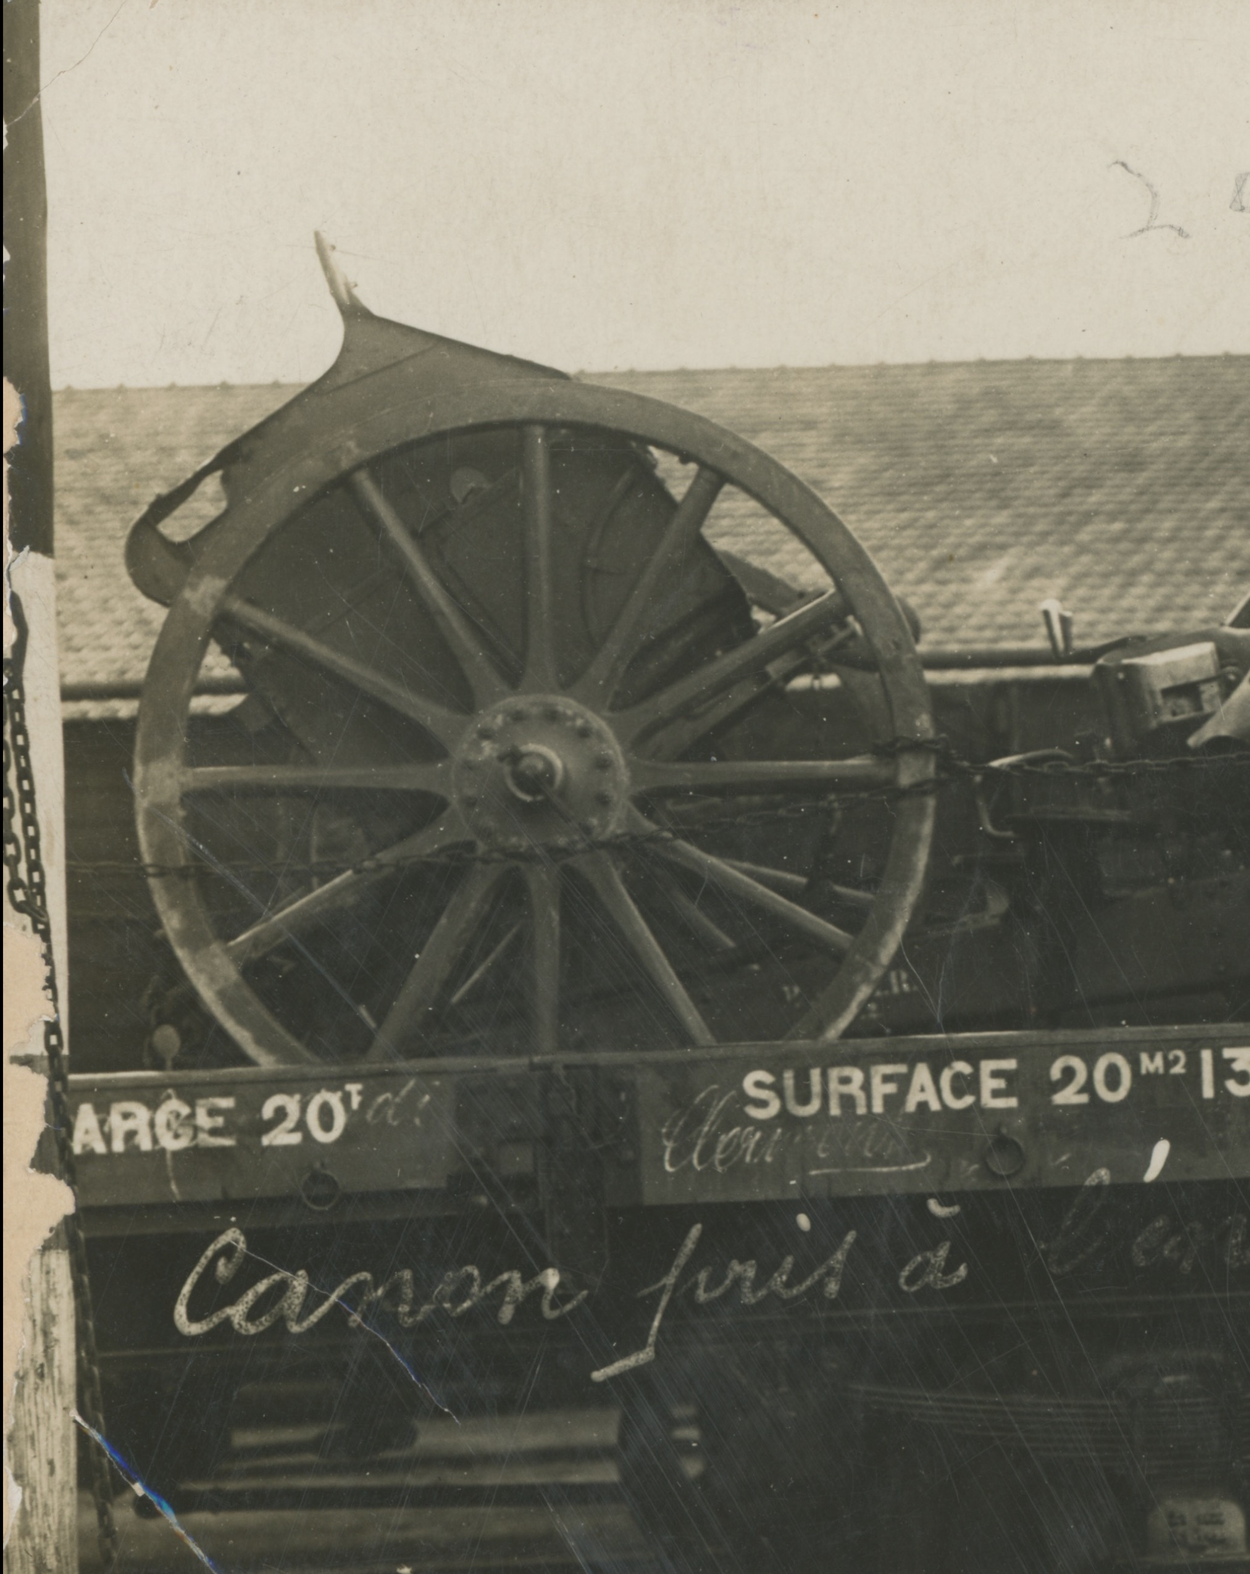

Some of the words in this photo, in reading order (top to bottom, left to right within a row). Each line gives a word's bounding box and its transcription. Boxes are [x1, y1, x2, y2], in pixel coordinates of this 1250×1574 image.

[742, 1058, 1019, 1119] SURFACE
[173, 1228, 589, 1336] Canon
[591, 1213, 857, 1382] pris
